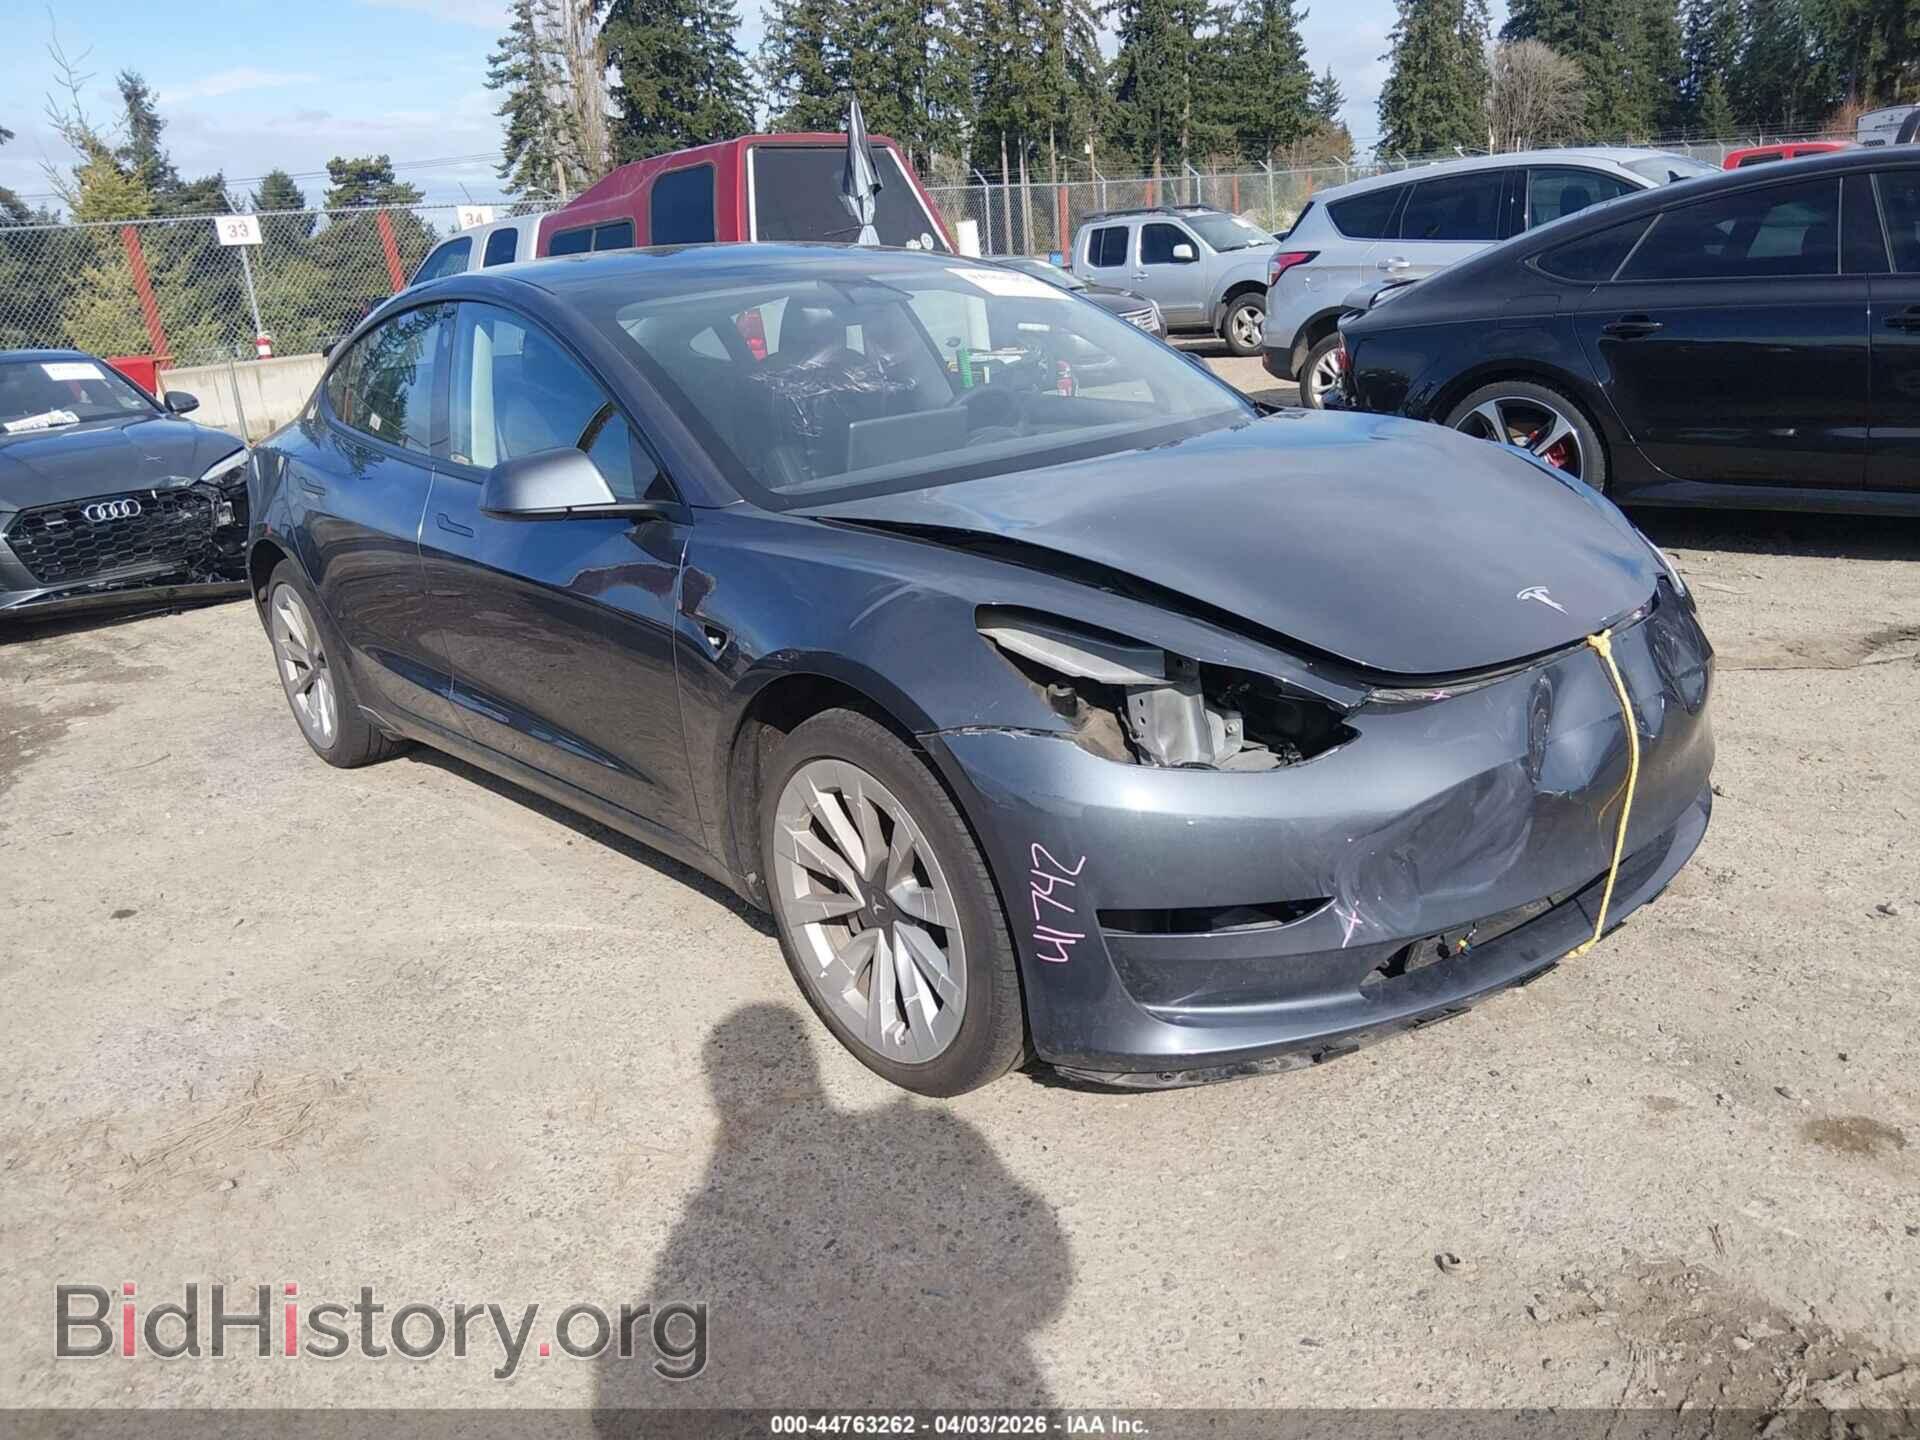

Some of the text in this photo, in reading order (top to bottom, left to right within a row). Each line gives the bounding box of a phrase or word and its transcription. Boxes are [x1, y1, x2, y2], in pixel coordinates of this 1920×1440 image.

[464, 212, 484, 225] 34
[227, 221, 250, 238] 33
[1029, 842, 1087, 963] 41742
